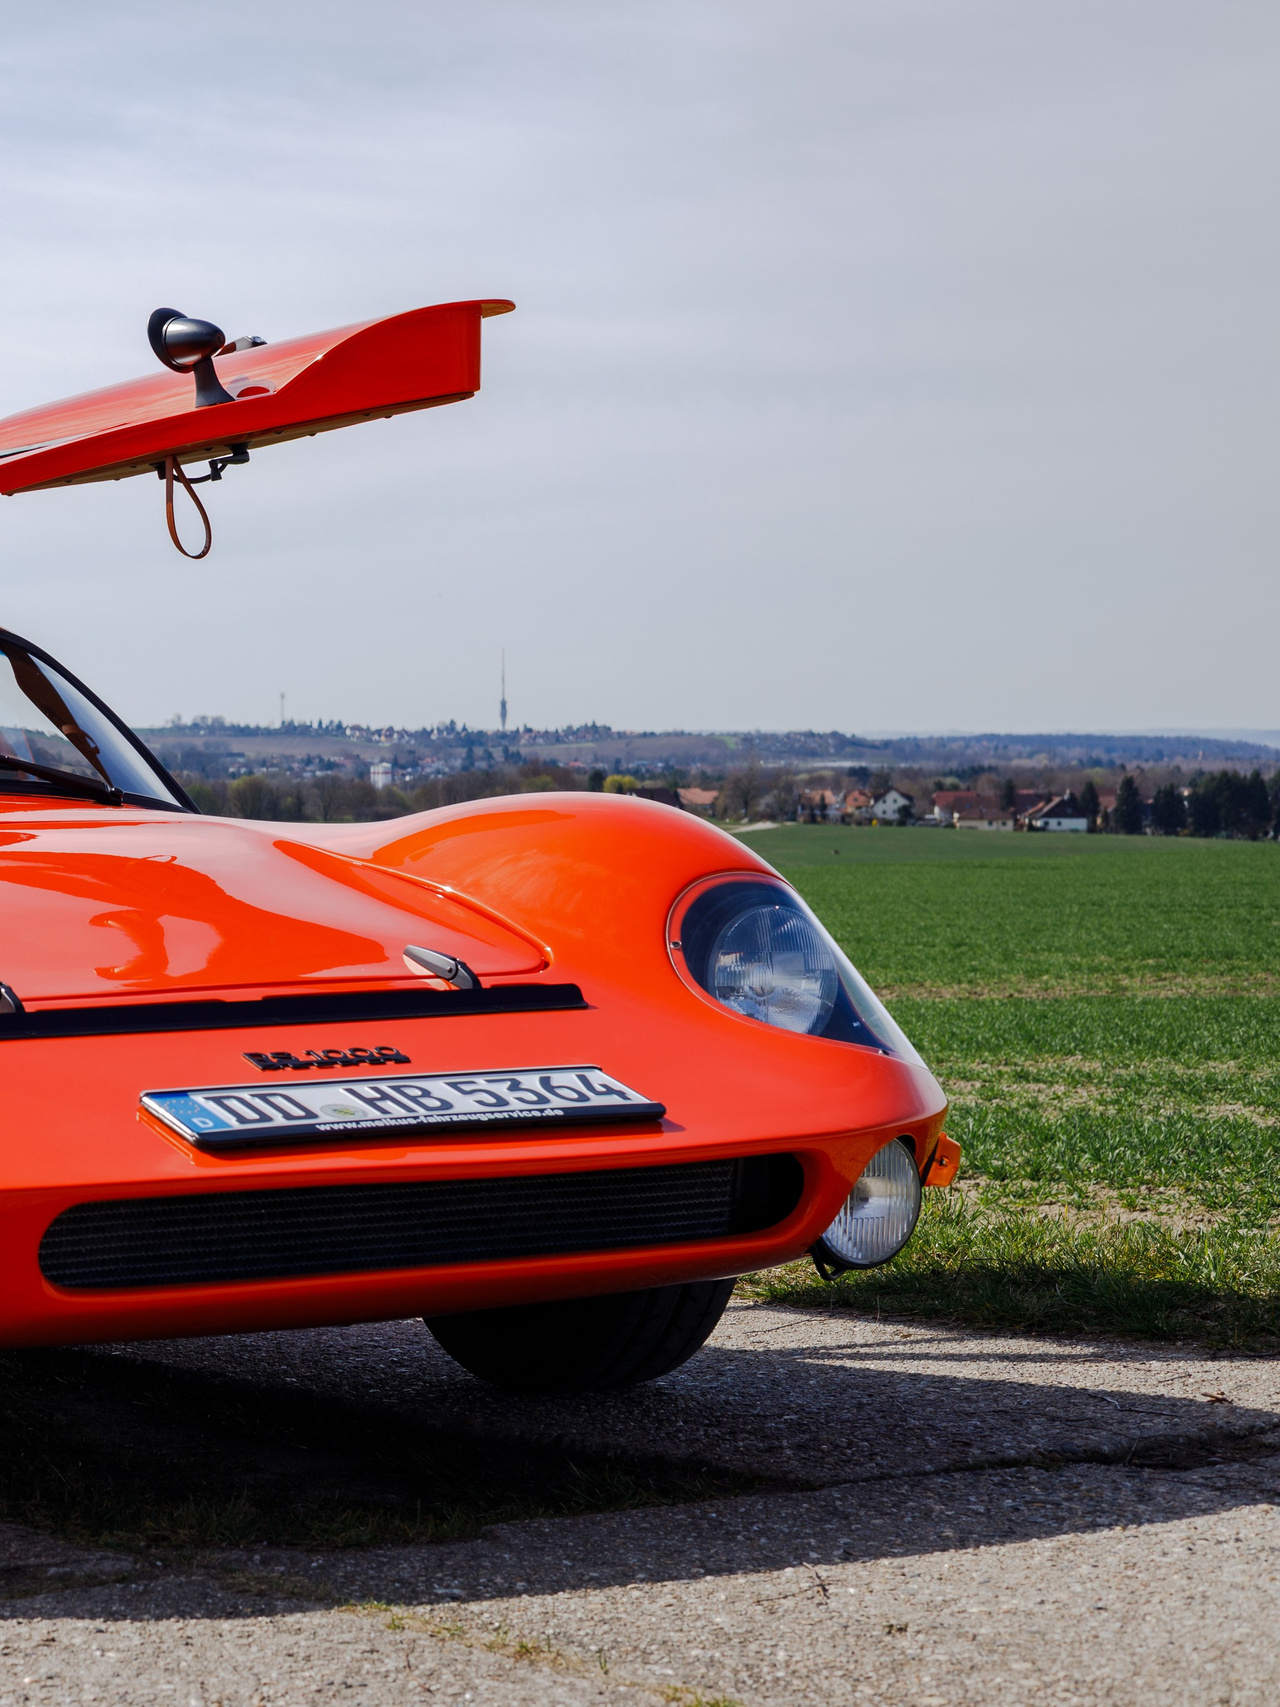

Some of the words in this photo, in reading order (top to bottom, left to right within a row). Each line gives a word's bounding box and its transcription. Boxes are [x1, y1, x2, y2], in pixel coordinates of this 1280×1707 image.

[201, 1091, 320, 1126] DD
[339, 1083, 454, 1116] HB
[444, 1073, 632, 1108] 5364
[190, 1116, 215, 1129] D
